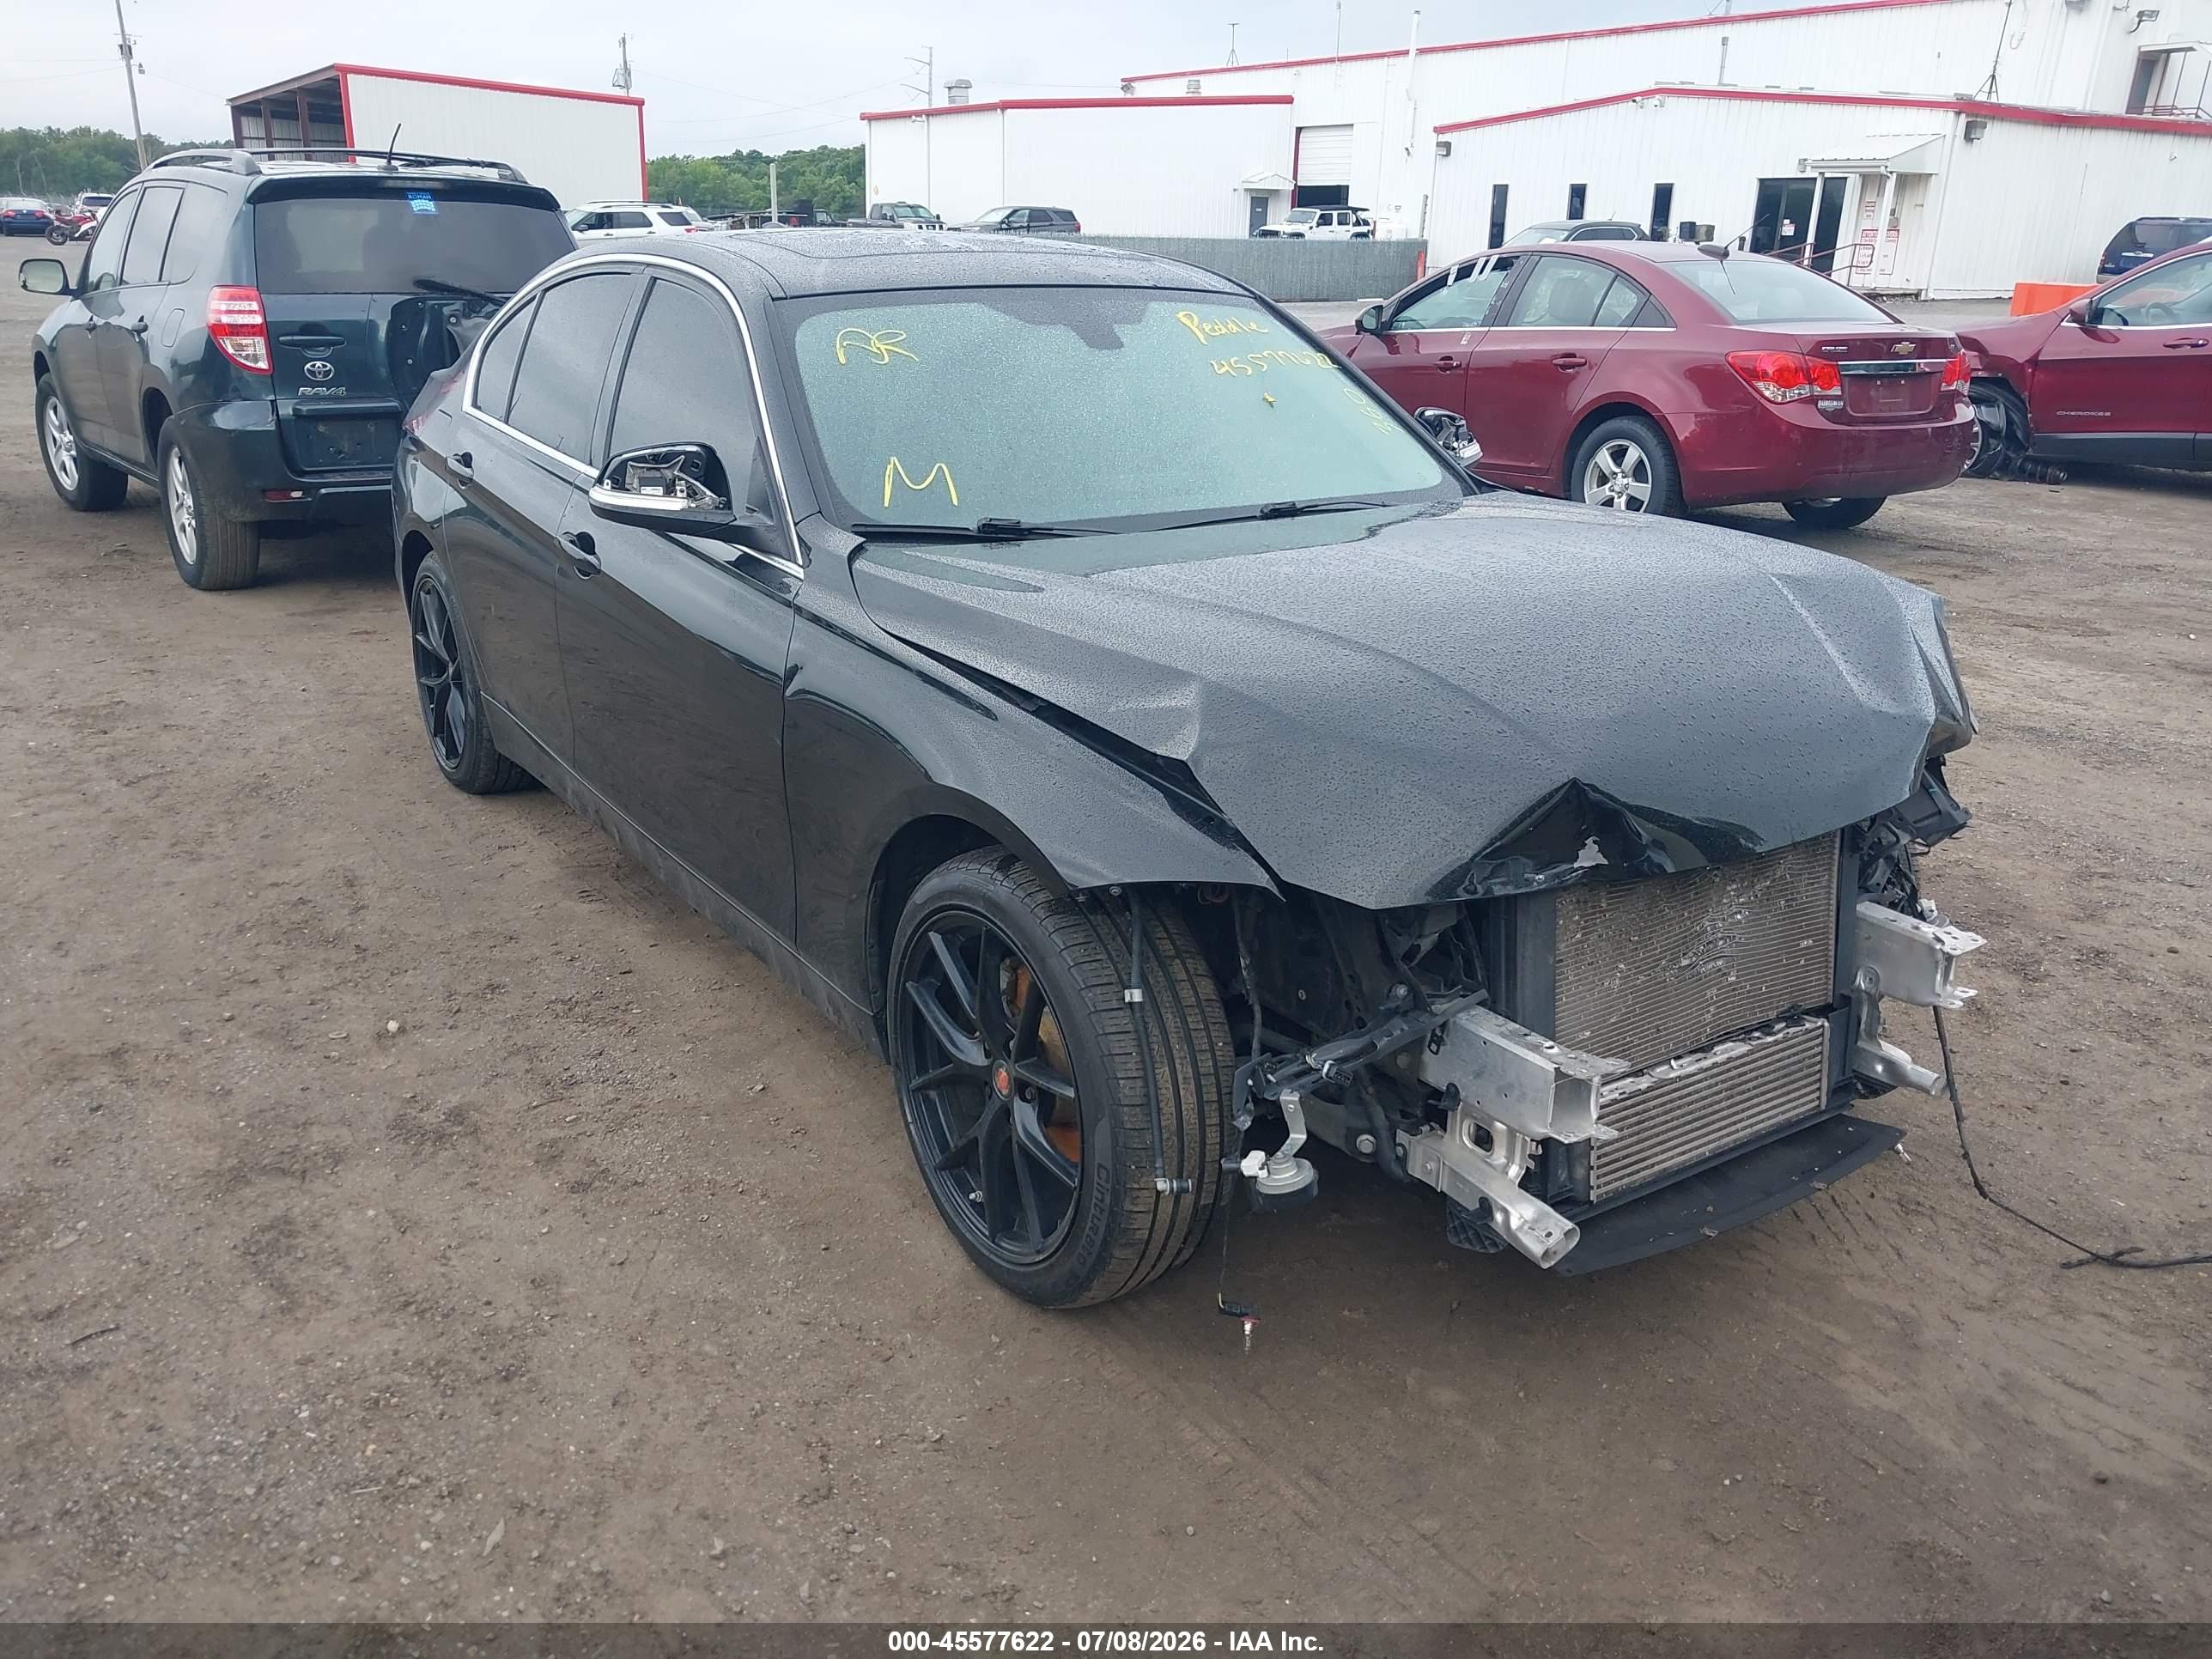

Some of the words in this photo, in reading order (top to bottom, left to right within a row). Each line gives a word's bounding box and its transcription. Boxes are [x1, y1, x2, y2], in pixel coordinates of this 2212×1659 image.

[1176, 311, 1269, 345] Peddle
[298, 386, 347, 397] RAV4
[884, 455, 958, 508] M
